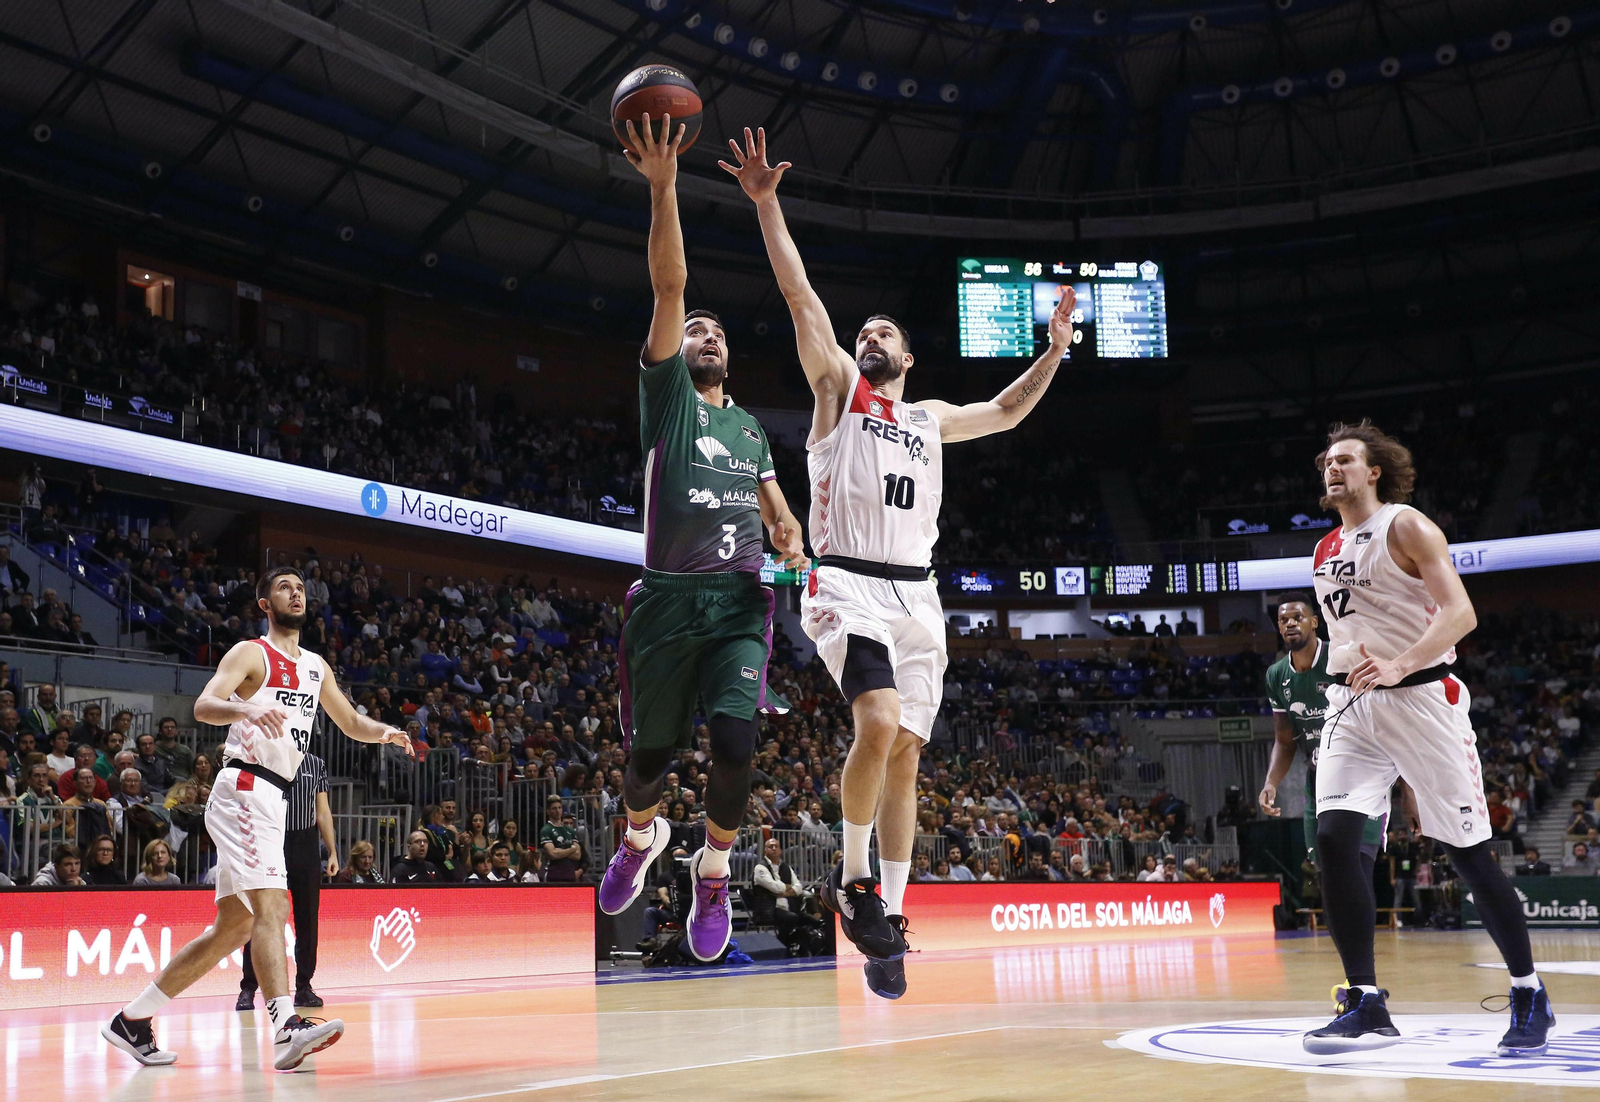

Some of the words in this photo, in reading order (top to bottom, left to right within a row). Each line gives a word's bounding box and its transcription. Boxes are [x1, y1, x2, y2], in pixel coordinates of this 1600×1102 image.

[1024, 262, 1042, 276] 56
[1079, 262, 1098, 277] 50
[18, 377, 48, 392] Unicaja
[148, 407, 173, 421] Unicaja
[862, 417, 924, 456] RETA
[884, 472, 915, 510] 10
[401, 490, 509, 534] Madegar
[718, 524, 737, 560] 3
[1115, 565, 1153, 573] ROUSSELLE
[1115, 571, 1149, 579] MARTINEZ
[1313, 560, 1356, 579] ETA
[1019, 571, 1046, 591] 50
[1323, 588, 1356, 621] 12
[276, 690, 314, 713] RETA
[291, 728, 308, 753] 83
[991, 904, 1053, 932] COSTA
[1057, 903, 1092, 928] DEL
[1095, 902, 1128, 927] SOL
[1132, 895, 1192, 926] MÁLAGA
[1523, 899, 1599, 921] Unicaja
[0, 931, 44, 980] L
